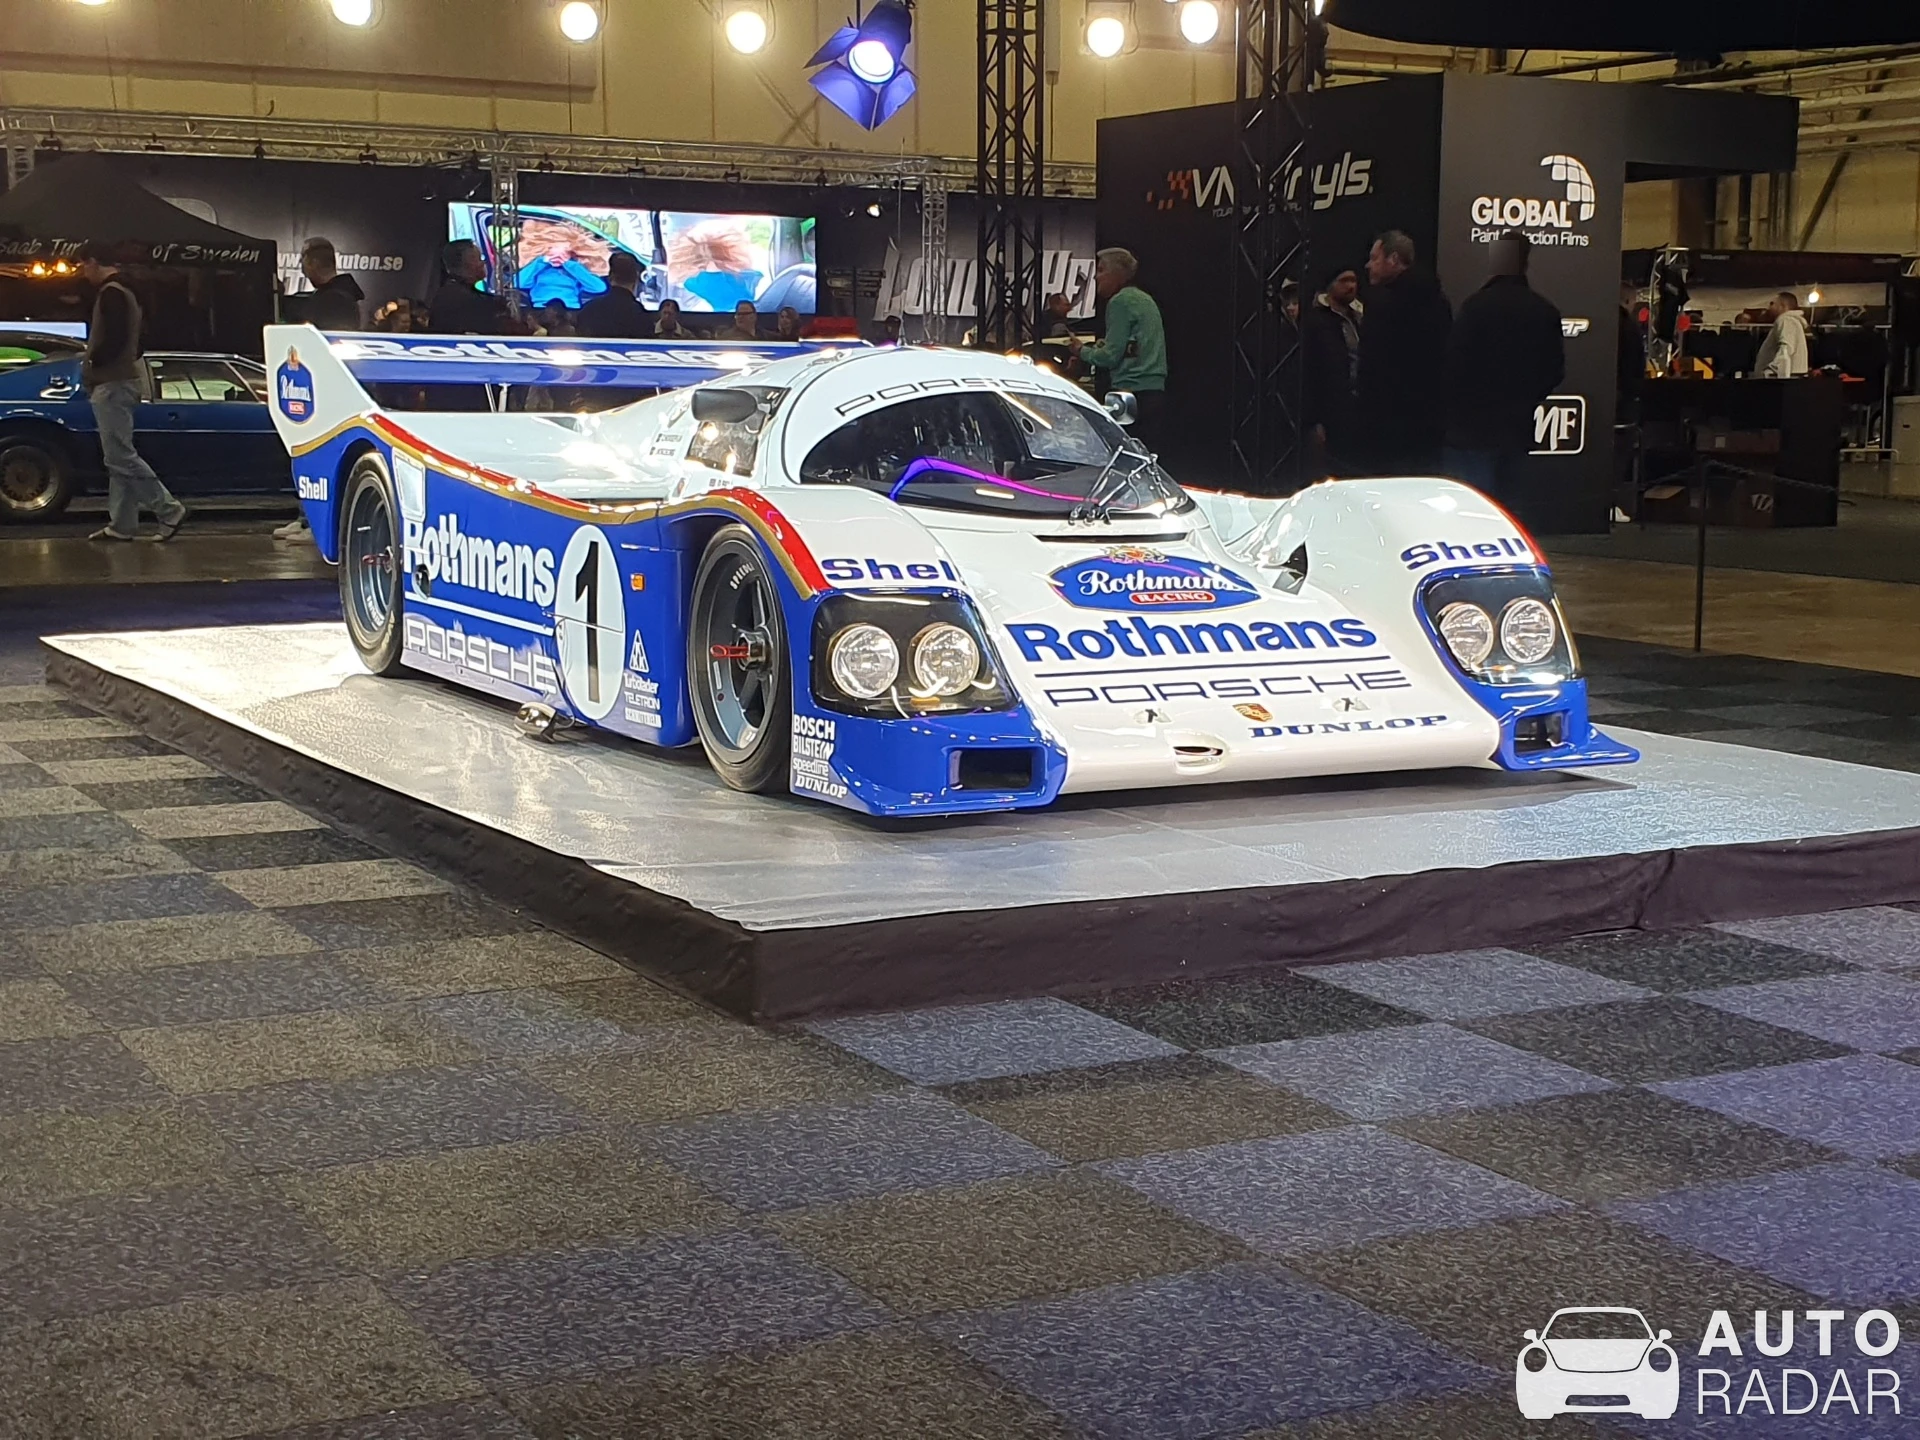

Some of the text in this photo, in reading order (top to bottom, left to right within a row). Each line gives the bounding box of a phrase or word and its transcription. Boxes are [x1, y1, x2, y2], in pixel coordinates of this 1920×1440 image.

[1471, 196, 1572, 228] GLOBAL
[1471, 228, 1500, 243] Paint
[1560, 231, 1590, 246] Films
[152, 243, 178, 262] of
[180, 244, 261, 264] Sweden
[298, 475, 328, 501] Shell
[403, 513, 555, 607] Rothmans
[1400, 537, 1527, 570] Shell
[821, 558, 957, 582] Shel
[1077, 568, 1241, 596] Rothmans
[1137, 591, 1208, 603] RACING
[575, 541, 600, 703] 1
[1003, 616, 1377, 662] Rothmans
[406, 619, 557, 694] PORSCHE
[1042, 670, 1412, 707] PORSCHE
[793, 714, 836, 740] BOSCH
[1248, 714, 1448, 739] DUNLOP
[793, 734, 835, 760] BILSTEIN
[795, 774, 848, 798] DUNLOP
